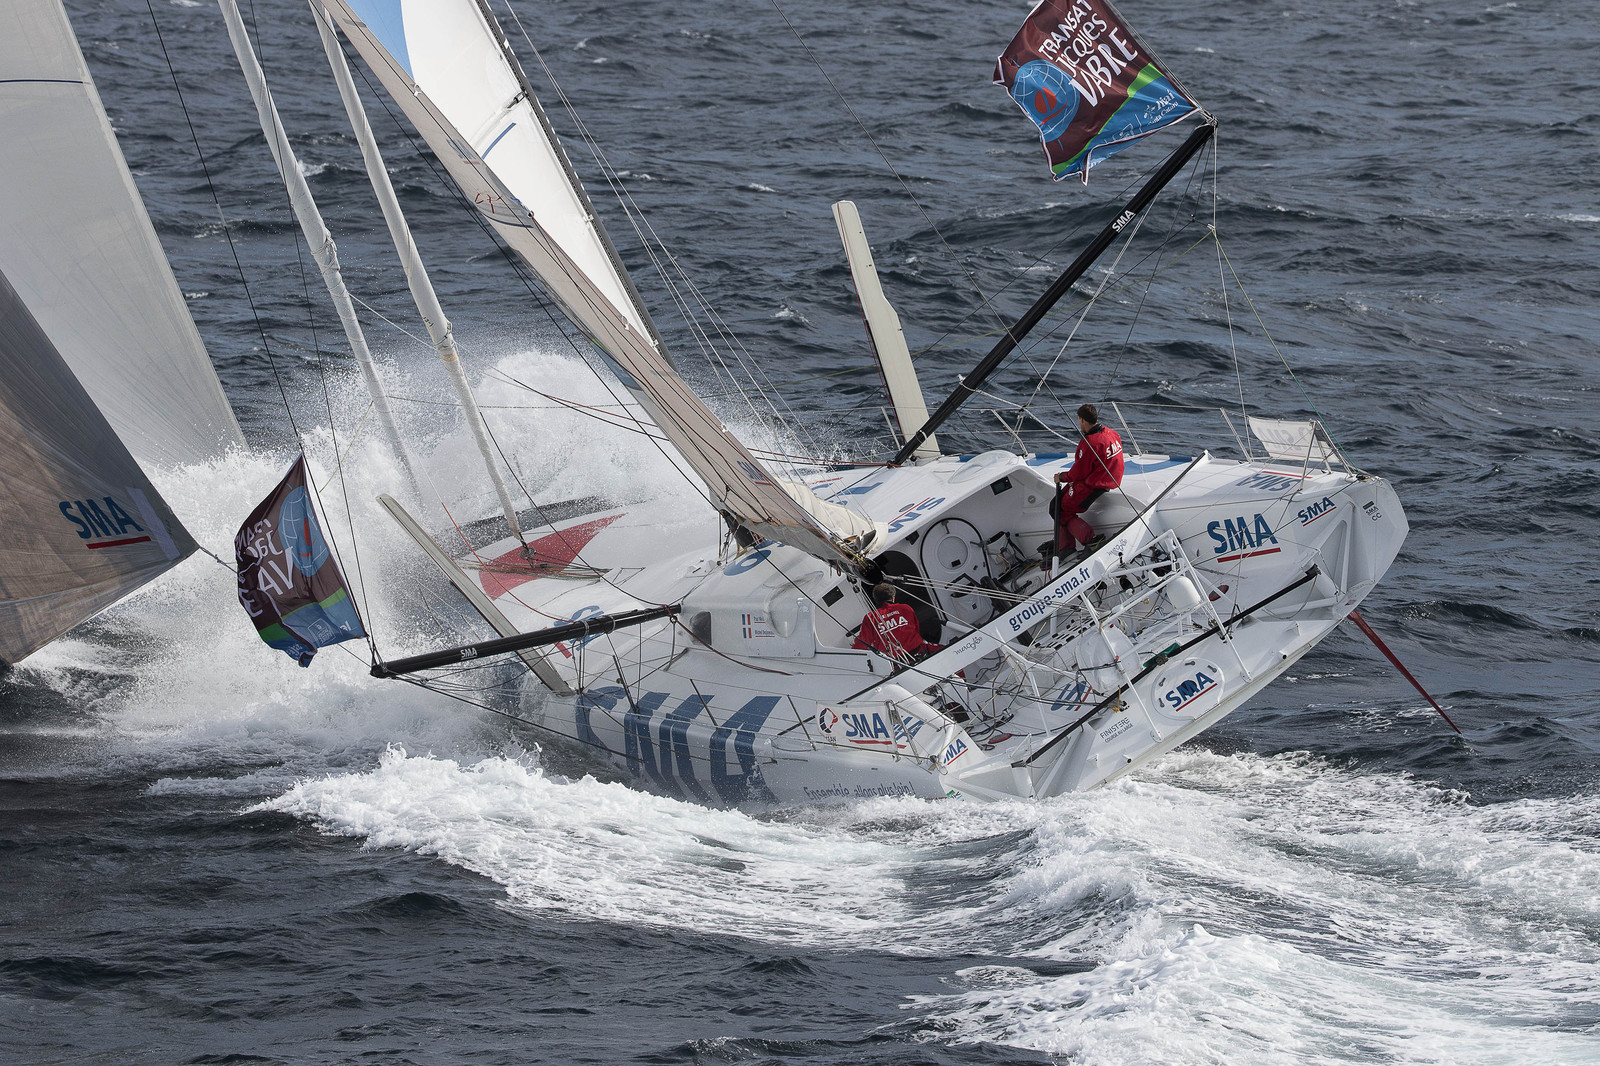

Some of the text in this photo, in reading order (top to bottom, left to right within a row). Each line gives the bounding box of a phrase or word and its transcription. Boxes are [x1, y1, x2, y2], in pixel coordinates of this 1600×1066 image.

[1038, 0, 1093, 60] TRANSAT
[1068, 27, 1138, 107] VABRE
[1111, 210, 1136, 232] SMA
[1106, 440, 1122, 457] SMA
[59, 496, 144, 539] SMA
[1297, 496, 1336, 524] SMA
[1207, 513, 1278, 554] SMA
[1008, 566, 1091, 631] groupe-sma.fr
[878, 615, 909, 633] SMA
[460, 647, 478, 659] SMA
[1166, 671, 1215, 709] SMA
[841, 712, 890, 739] SMA
